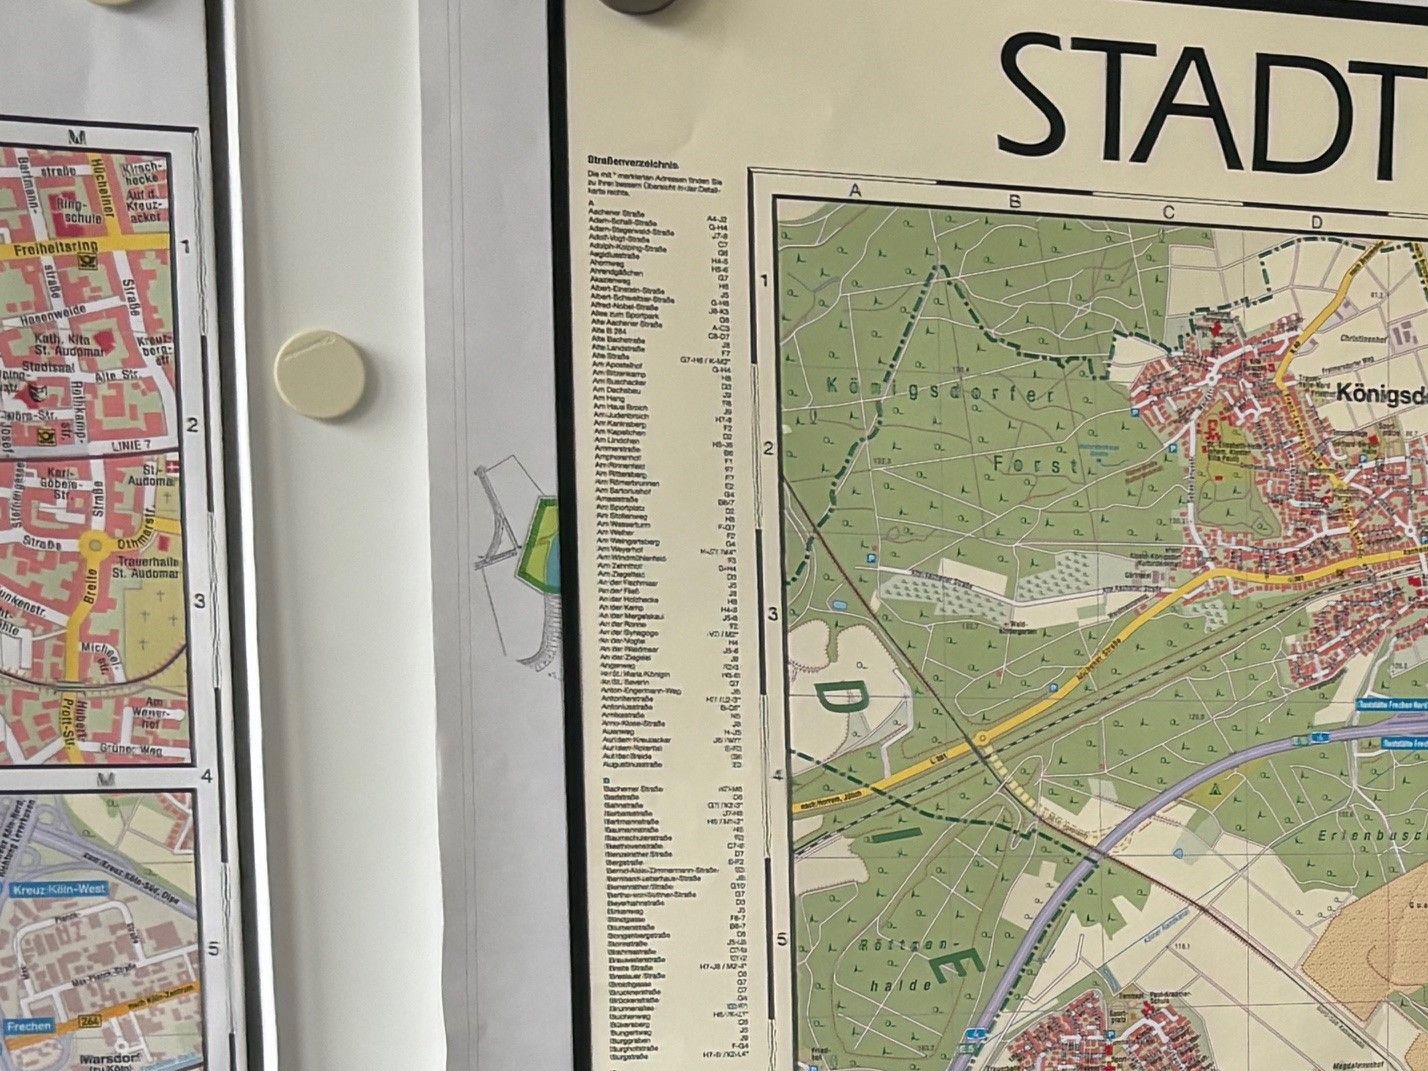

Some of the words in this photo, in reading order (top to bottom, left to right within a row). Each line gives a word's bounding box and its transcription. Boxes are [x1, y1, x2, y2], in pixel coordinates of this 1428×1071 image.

[68, 130, 86, 145] M
[849, 185, 861, 197] A
[1010, 195, 1021, 208] B
[1163, 206, 1174, 218] C
[1312, 216, 1322, 228] D
[14, 241, 98, 256] Freiheitsring
[181, 240, 190, 253] 1
[186, 418, 198, 432] 2
[764, 442, 773, 455] 2
[0, 588, 46, 617] unkenstr.
[768, 608, 779, 620] 3
[8, 1022, 50, 1031] Frechen
